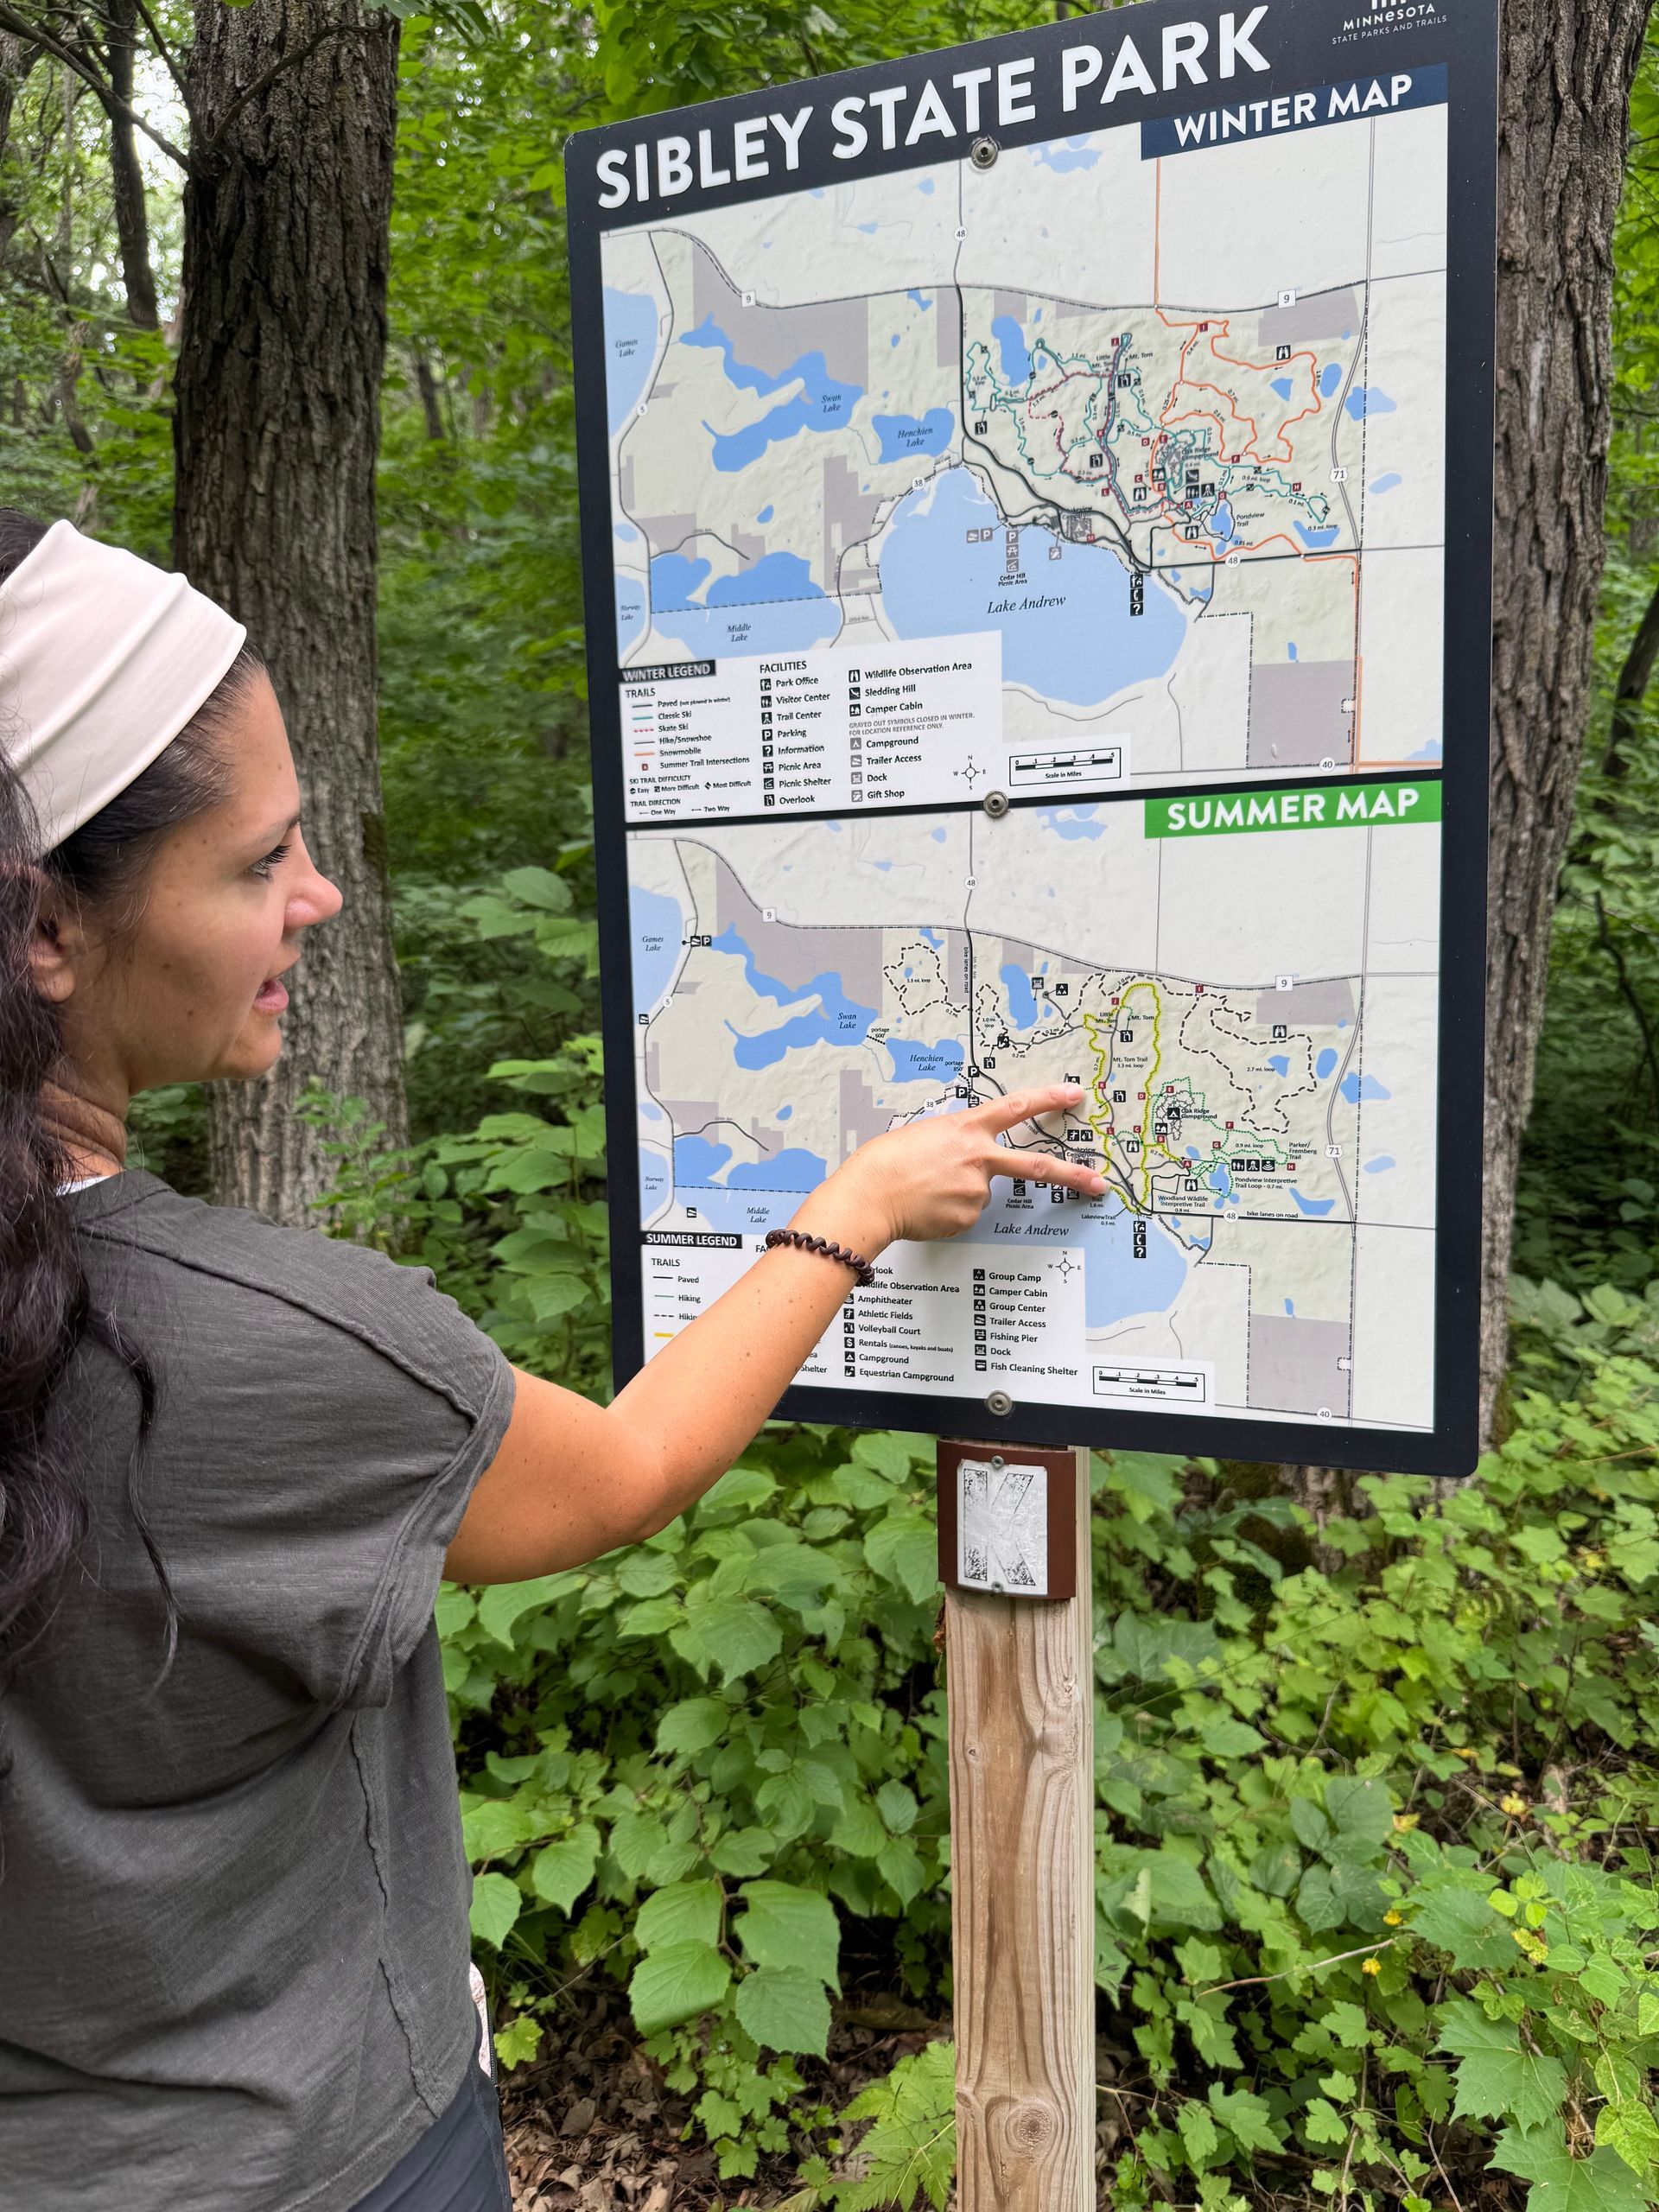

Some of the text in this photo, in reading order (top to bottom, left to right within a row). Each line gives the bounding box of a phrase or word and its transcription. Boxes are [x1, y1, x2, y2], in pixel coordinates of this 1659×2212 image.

[1332, 15, 1447, 45] STATE PARKS AND TRAILS
[597, 6, 1271, 210] SIBLEY STATE PARK
[1173, 74, 1412, 147] WINTER MAP
[615, 338, 639, 348] Games
[619, 348, 635, 358] Lake
[821, 394, 842, 404] Swan
[823, 404, 841, 412] Lake
[906, 438, 925, 448] Lake
[1333, 470, 1345, 479] 71
[1236, 511, 1265, 520] Pondview
[987, 595, 1066, 614] Lake Andrew
[728, 624, 752, 633] Middle
[731, 633, 747, 643] Lake
[760, 660, 807, 674] FACILITIES
[865, 663, 972, 679] Wildlife Observation Area
[622, 663, 711, 682] WINTER LEGEND
[776, 677, 819, 688] Park Office
[626, 688, 656, 699] TRAILS
[865, 684, 916, 696] Sledding Hill
[776, 693, 830, 704] Visitor Center
[866, 702, 923, 715] Camper Cabin
[658, 710, 692, 721] Classic Ski
[777, 711, 822, 721] Trail Center
[658, 724, 677, 733] Skate
[778, 728, 807, 739] Parking
[861, 728, 891, 736] LOCATION
[893, 724, 925, 733] REFERENCE
[659, 734, 712, 745] Hike/Snowshoe
[866, 737, 918, 749] Campground
[659, 747, 702, 757] Snowmobile
[778, 745, 824, 754] Information
[660, 756, 750, 769] Summer Trail Intersections
[867, 754, 922, 766] Trailer Access
[779, 763, 801, 772] Picnic
[868, 772, 887, 782] Dock
[779, 778, 831, 788] Picnic Shelter
[868, 789, 905, 799] Gift Shop
[779, 795, 816, 804] Overlook
[1167, 788, 1420, 831] SUMMER MAP
[645, 944, 661, 952] Lake
[838, 1012, 857, 1020] Swan
[839, 1020, 856, 1029] Lake
[910, 1054, 944, 1064] Henchien
[918, 1063, 936, 1072] Lake
[747, 1206, 770, 1216] Middle
[750, 1215, 766, 1224] Lake
[994, 1223, 1070, 1236] Lake Andrew
[646, 1233, 737, 1246] SUMMER LEGEND
[652, 1258, 681, 1267] TRAILS
[988, 1272, 1041, 1283] Group Camp
[890, 1281, 939, 1292] Observation
[989, 1287, 1048, 1298] Camper Cabin
[678, 1294, 702, 1303] Hiking
[858, 1295, 912, 1306] Amphitheater
[989, 1303, 1046, 1313] Group Center
[858, 1310, 888, 1319] Athletic
[989, 1318, 1046, 1328] Trailer Access
[858, 1325, 897, 1335] Volleyball
[990, 1332, 1019, 1343] Fishing
[990, 1347, 1011, 1356] Dock
[859, 1353, 910, 1363] Campground
[991, 1363, 1078, 1376] Fish Cleaning Shelter
[860, 1368, 954, 1382] Equestrian Campground
[963, 1467, 1036, 1586] K
